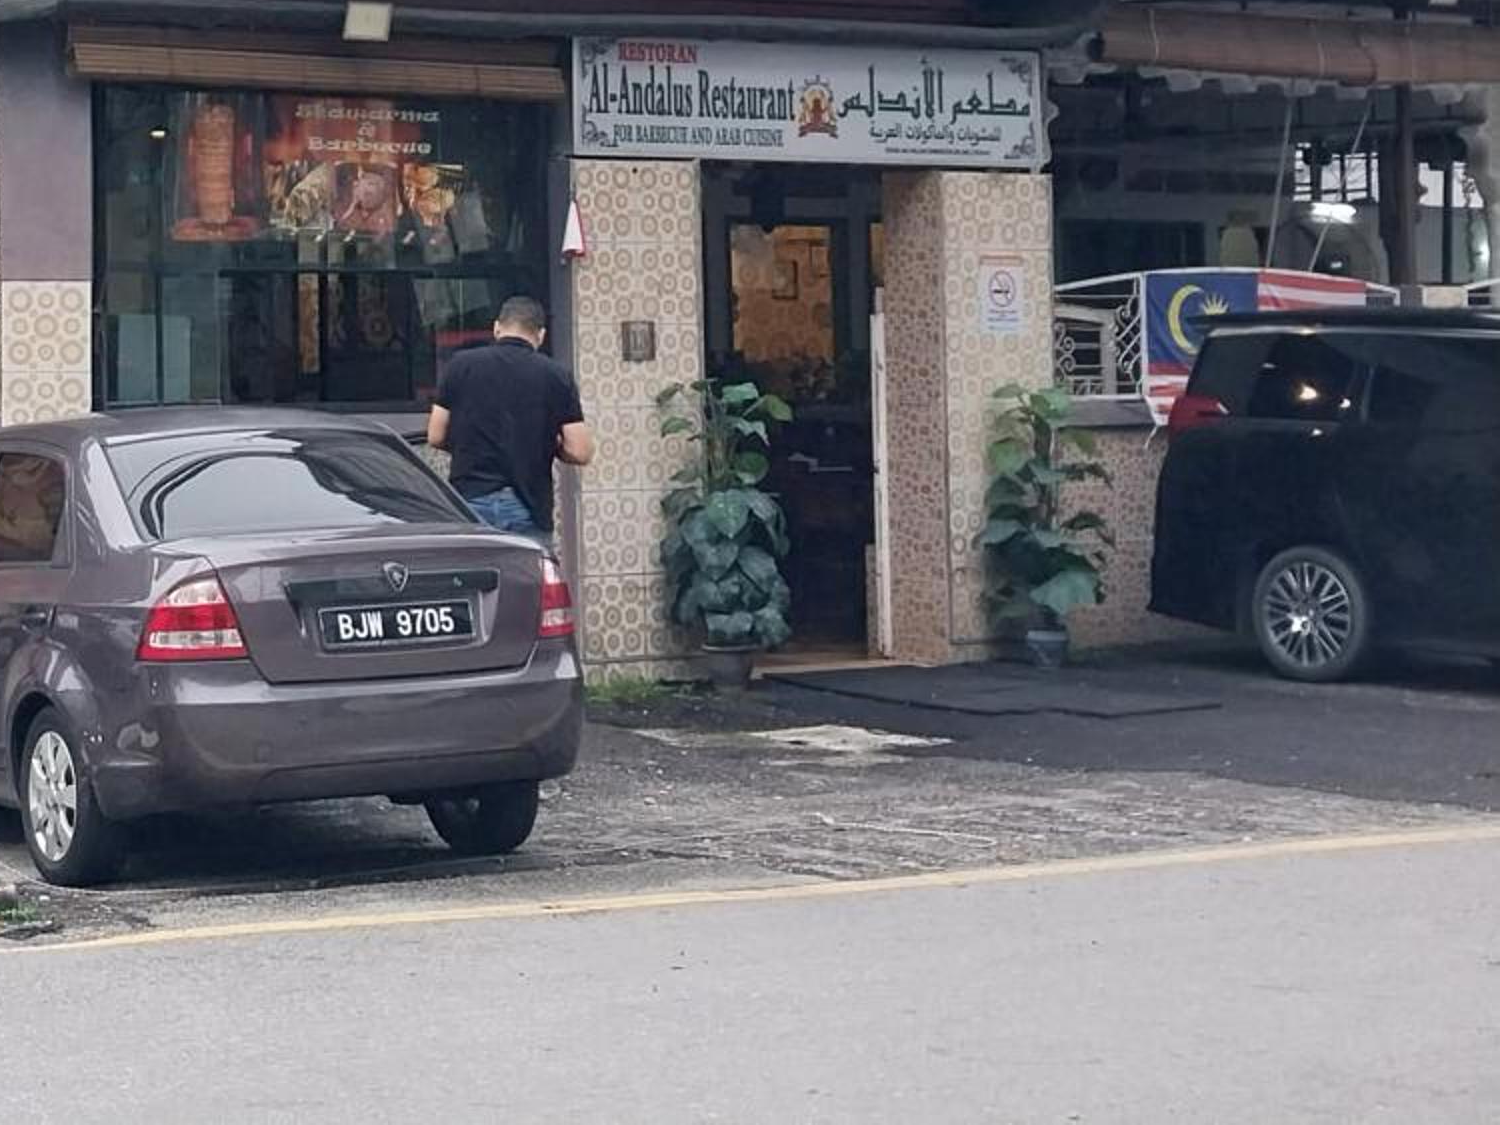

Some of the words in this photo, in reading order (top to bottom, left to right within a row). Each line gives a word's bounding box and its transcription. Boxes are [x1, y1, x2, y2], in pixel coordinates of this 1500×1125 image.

[618, 42, 698, 64] RESTORAN
[588, 62, 693, 118] Al-Andalus
[697, 69, 796, 121] Restaurant
[950, 72, 1031, 125] مطعم
[308, 136, 432, 154] Barbecue
[613, 124, 634, 143] FOR
[635, 125, 687, 145] BARBECUE
[691, 127, 713, 146] AND
[714, 128, 741, 146] ARAB
[743, 129, 784, 147] CUISINE
[337, 610, 383, 641] BJW
[397, 606, 455, 636] 9705
